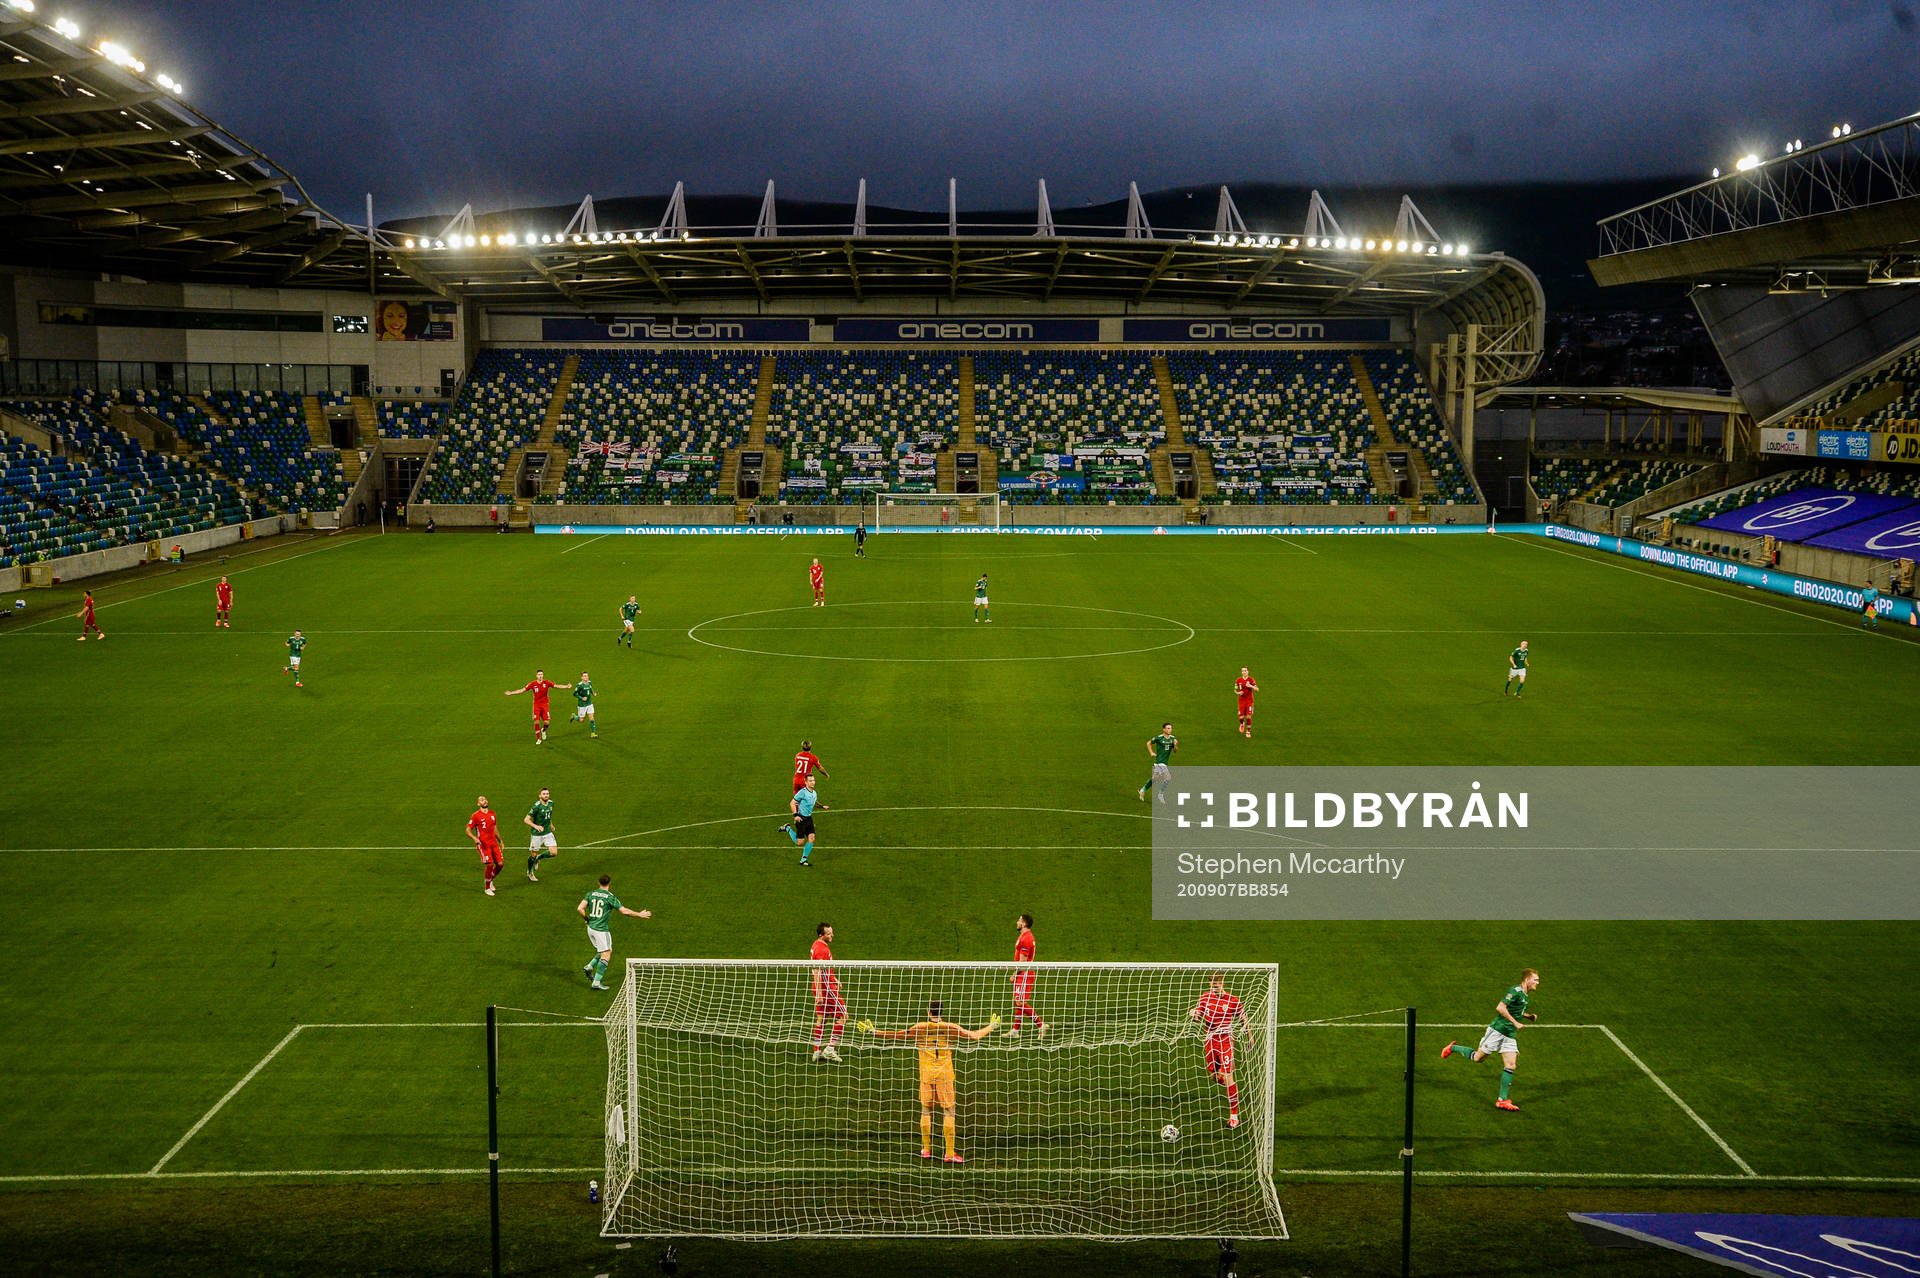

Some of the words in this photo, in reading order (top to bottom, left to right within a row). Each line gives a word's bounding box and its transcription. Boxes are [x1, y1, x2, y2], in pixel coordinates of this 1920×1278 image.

[608, 323, 744, 338] onecom
[898, 323, 1034, 338] onecom
[1188, 323, 1324, 338] onecom
[1766, 440, 1800, 453] LOUDMOUTH
[1769, 505, 1830, 520] BT
[1640, 545, 1676, 566] DOWNLOAD
[1676, 554, 1690, 570] THE
[1690, 557, 1722, 576] OFFICIAL
[1723, 564, 1738, 580] APP
[796, 760, 809, 773] 21
[589, 898, 604, 918] 16
